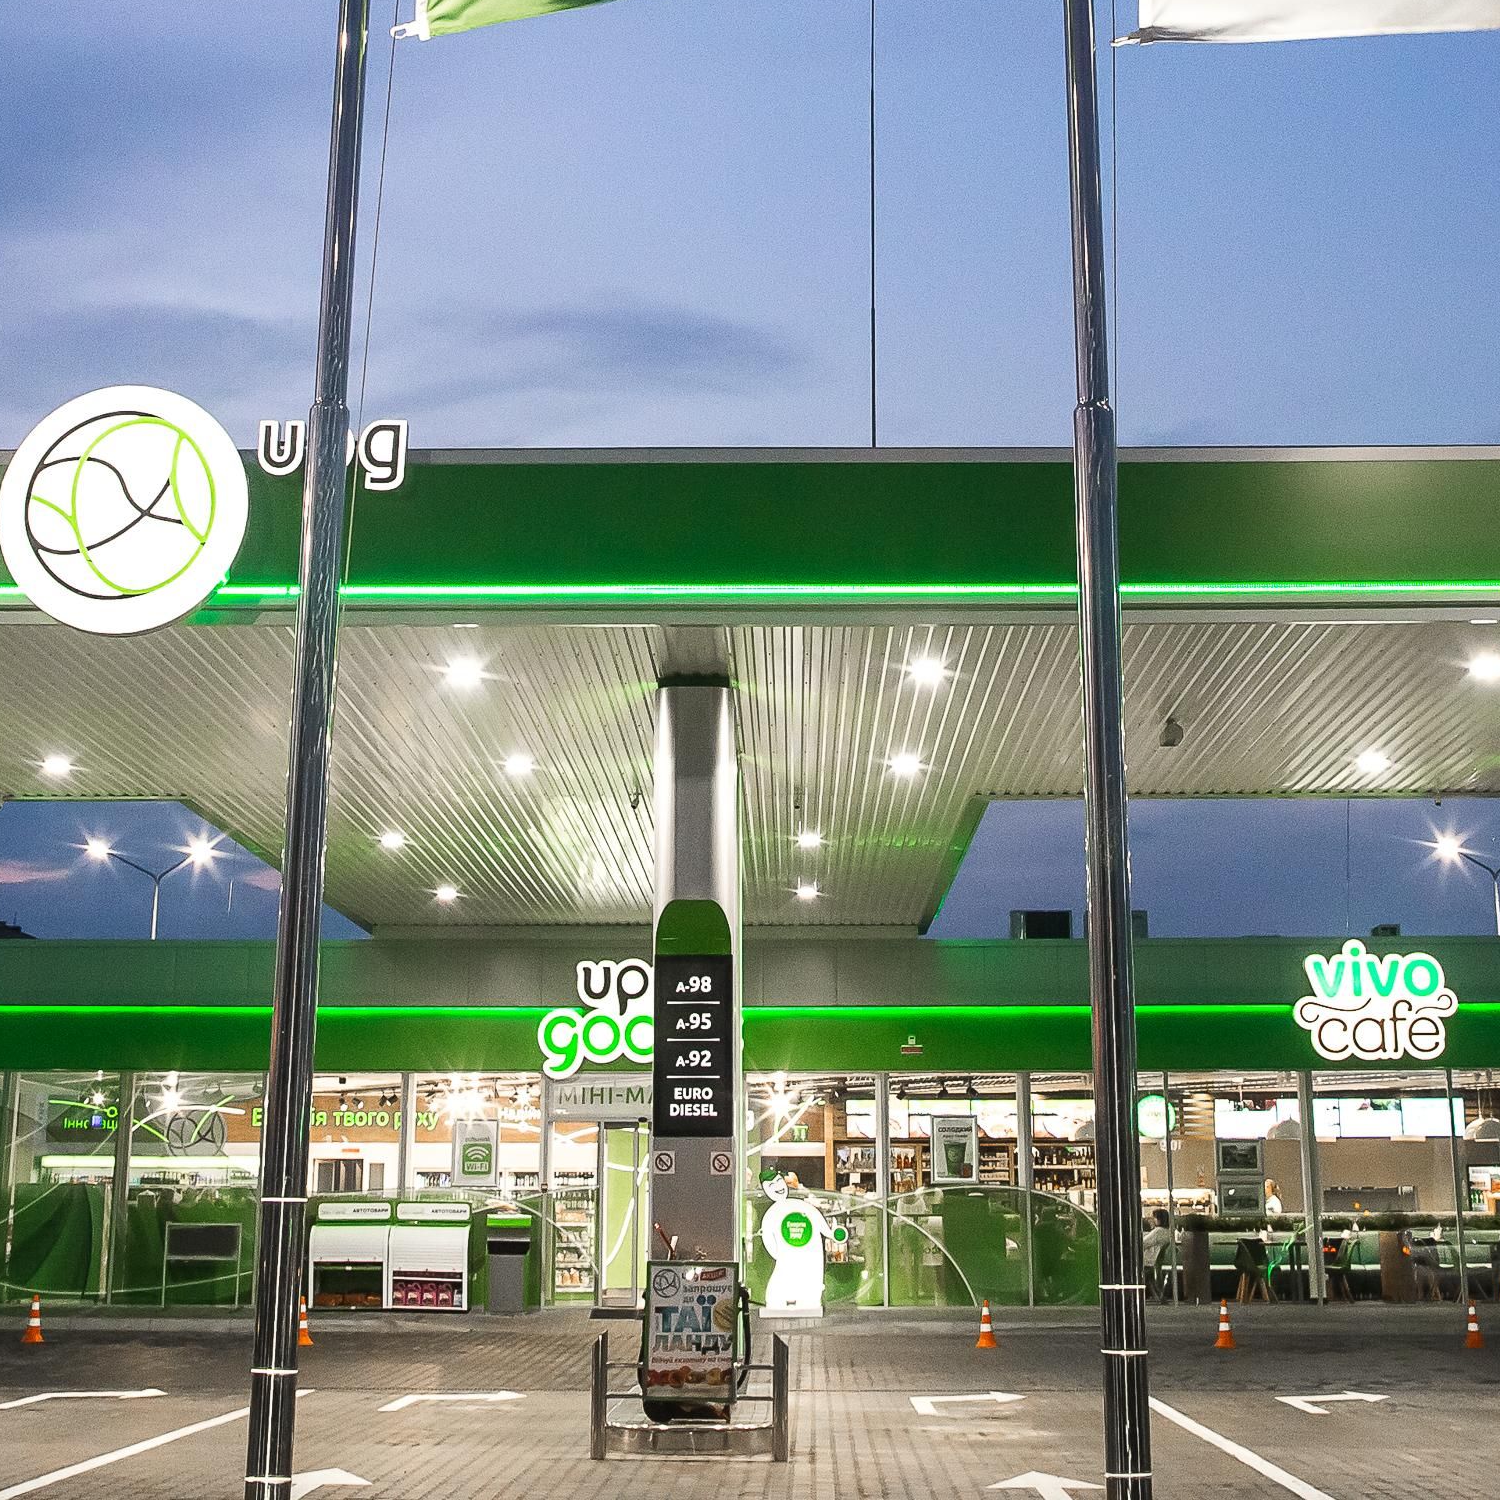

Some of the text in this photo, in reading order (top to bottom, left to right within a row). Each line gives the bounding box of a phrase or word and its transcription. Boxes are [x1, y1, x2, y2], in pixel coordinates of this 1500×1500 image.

[258, 420, 408, 490] ug
[1313, 947, 1439, 998] vivo
[676, 976, 712, 993] A-98
[676, 1013, 712, 1030] A-95
[1318, 999, 1440, 1053] cafe
[544, 1015, 654, 1072] goo
[676, 1050, 712, 1067] A-92
[559, 1087, 653, 1105] МІНІ-М
[674, 1088, 713, 1100] EURO
[670, 1104, 718, 1116] DIESEL
[333, 1111, 389, 1127] твого
[393, 1111, 438, 1131] рху
